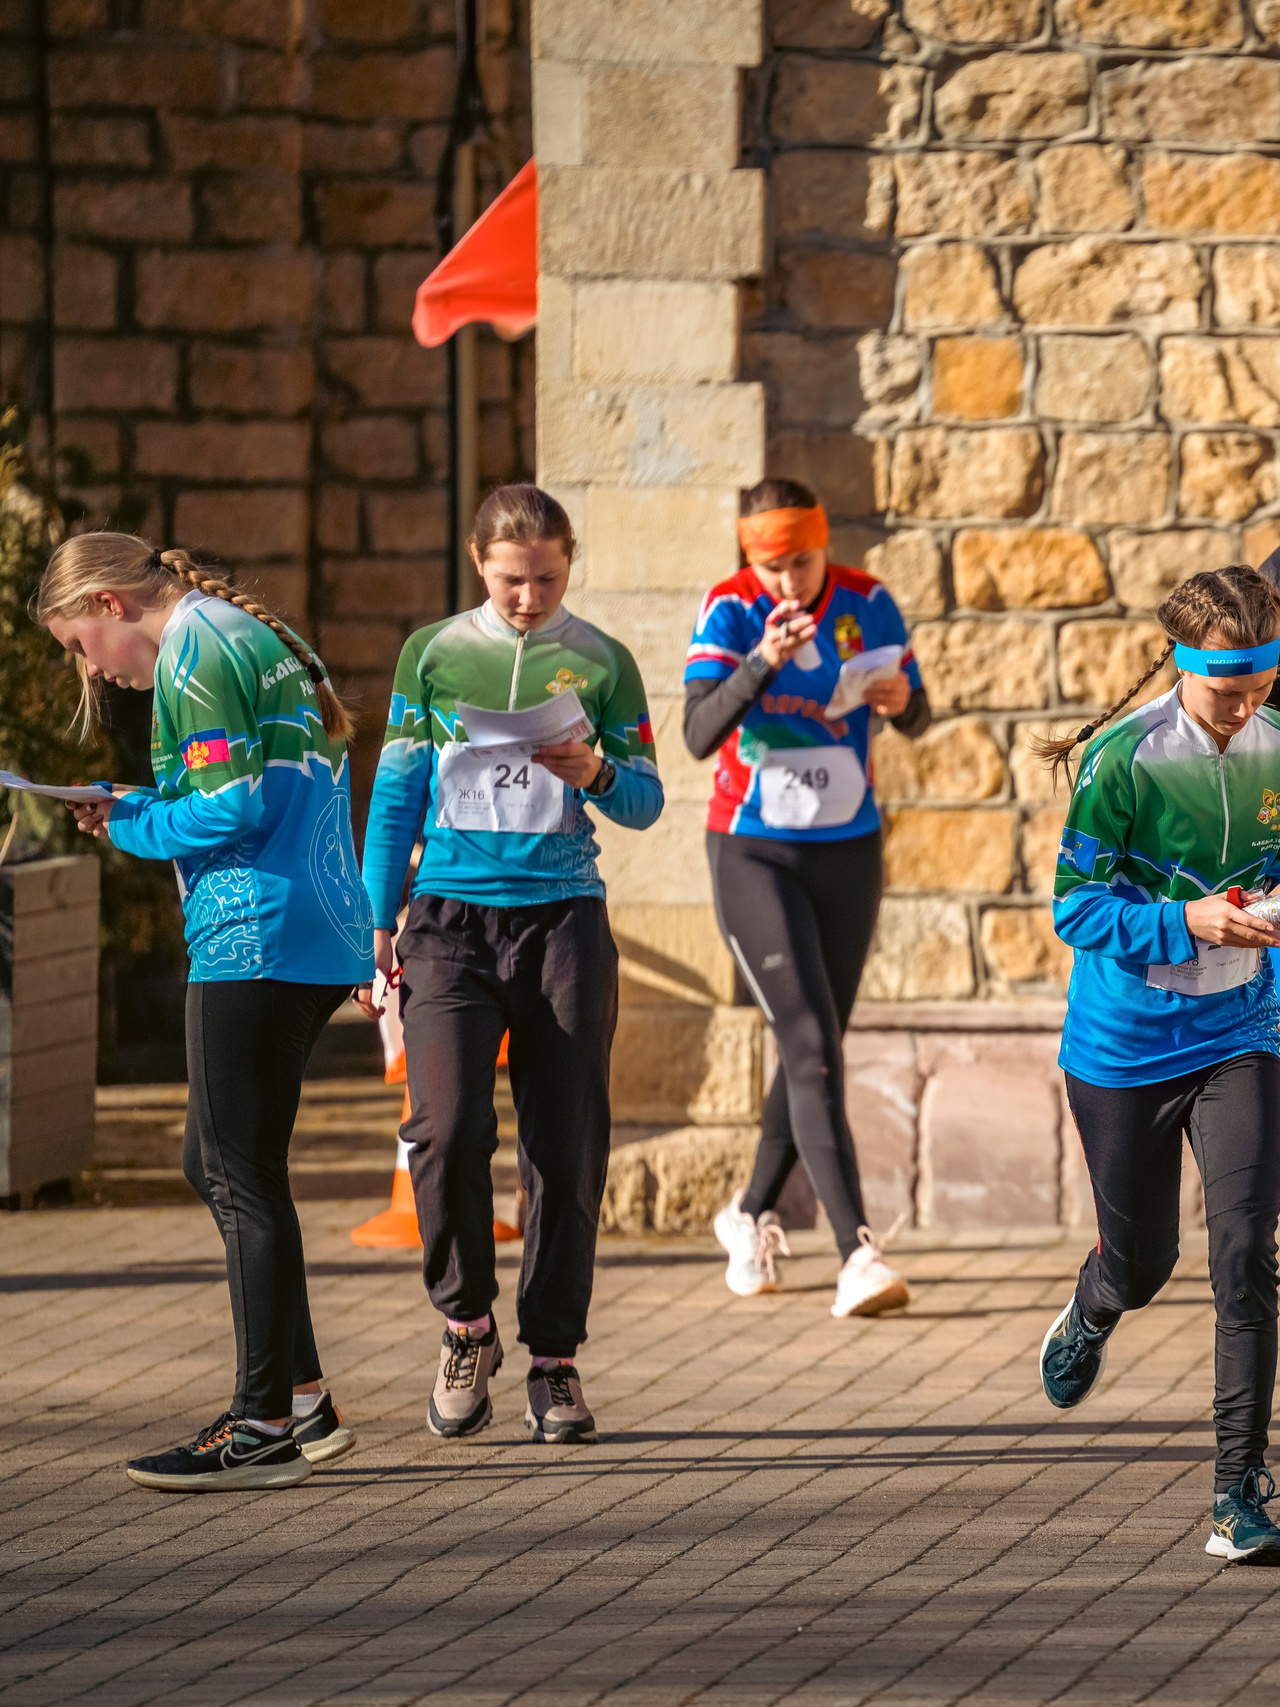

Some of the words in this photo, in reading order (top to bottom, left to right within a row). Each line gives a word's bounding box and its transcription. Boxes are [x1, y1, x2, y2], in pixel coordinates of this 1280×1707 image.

[494, 764, 531, 790] 24
[784, 767, 829, 790] 249
[458, 788, 485, 800] Ж16
